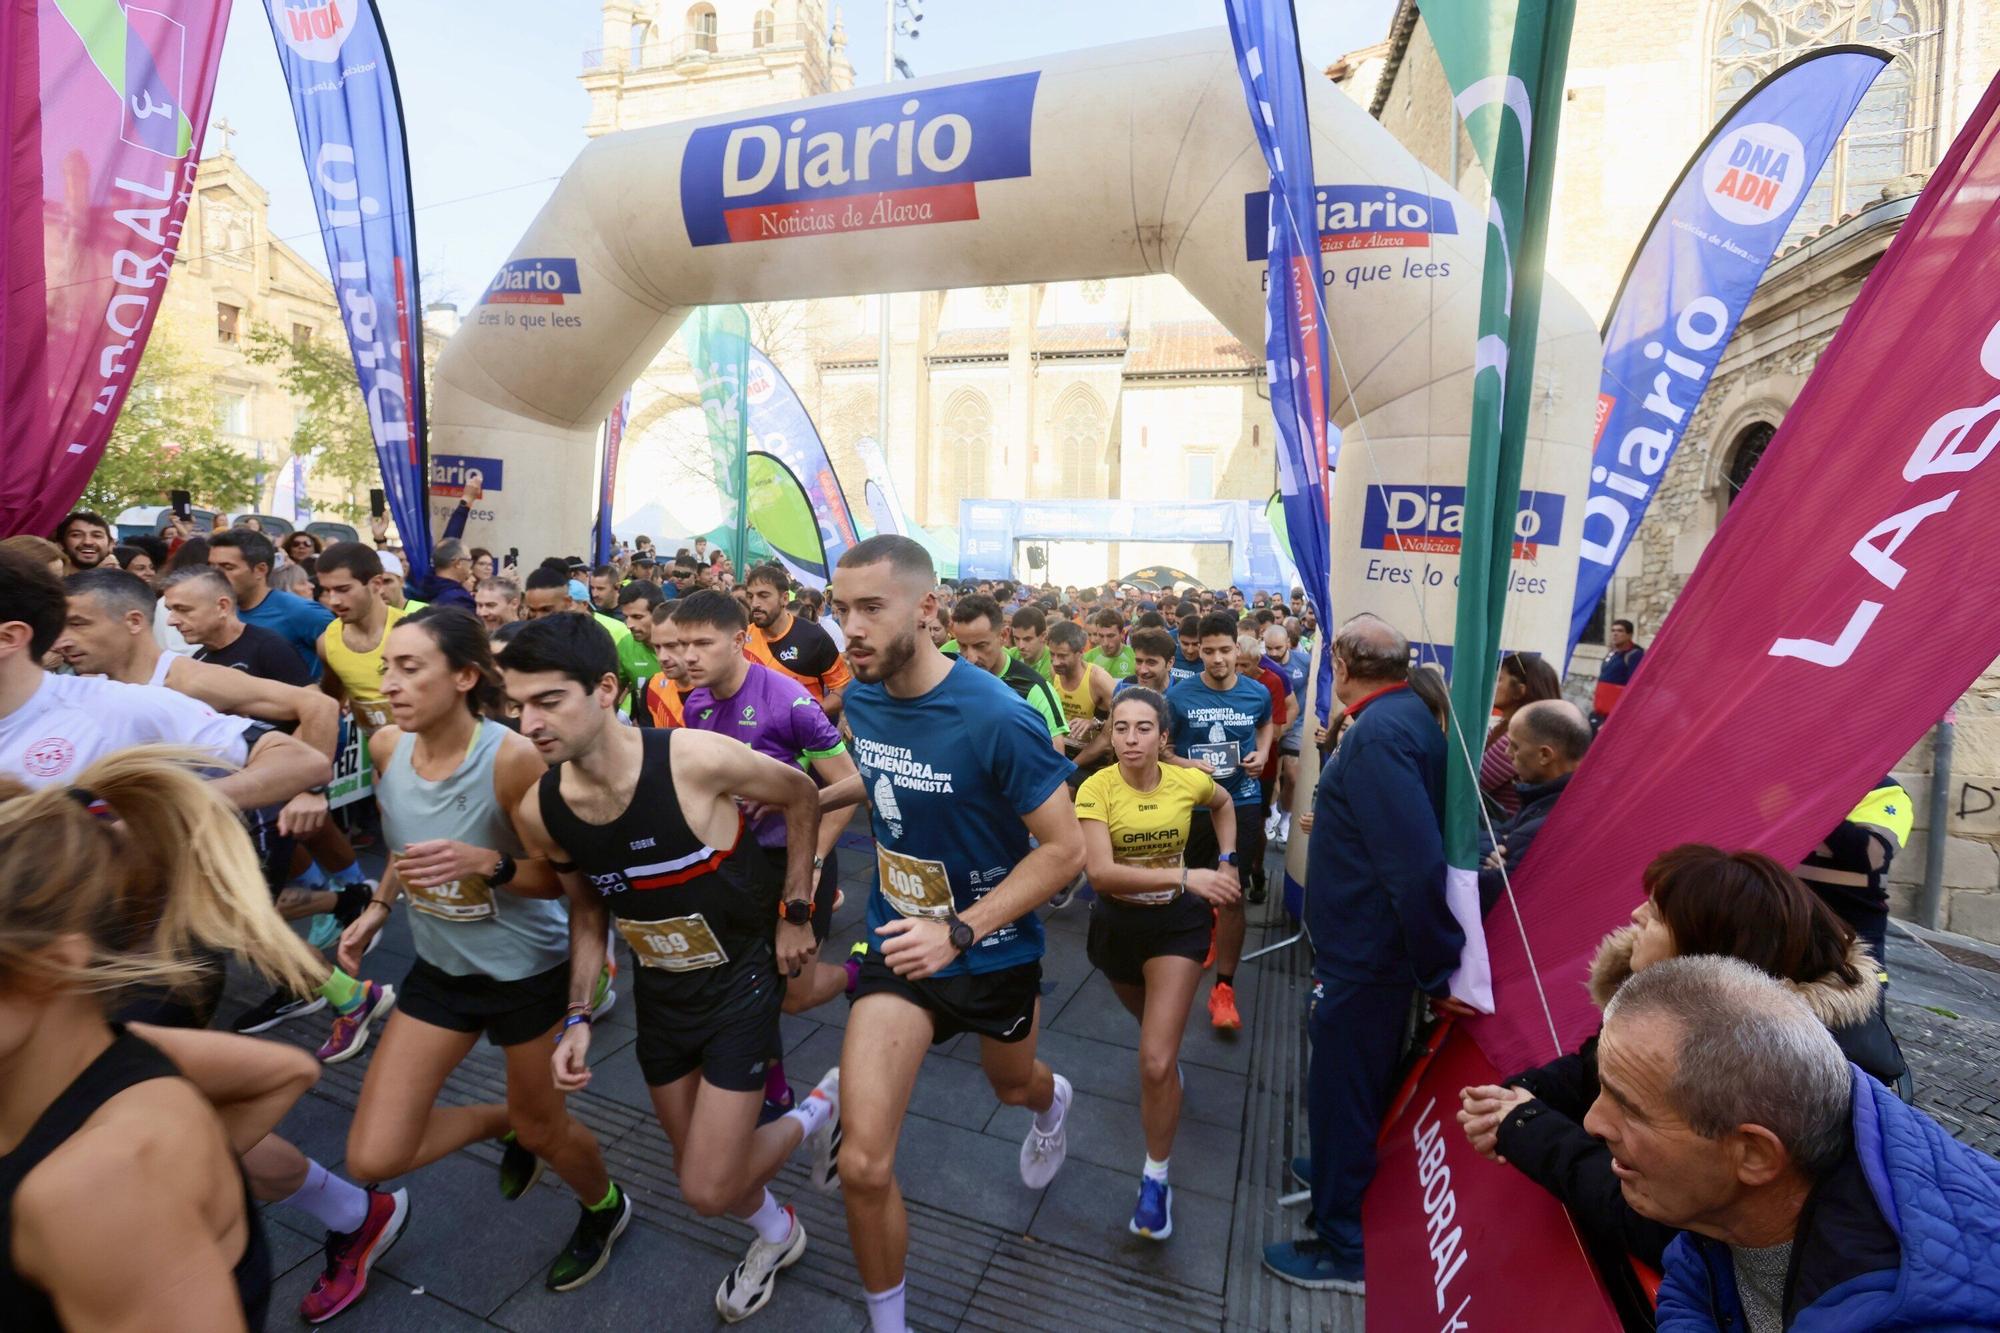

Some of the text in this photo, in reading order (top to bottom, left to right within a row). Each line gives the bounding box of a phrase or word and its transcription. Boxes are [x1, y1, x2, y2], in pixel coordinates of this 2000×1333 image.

[722, 99, 972, 197] Diario
[1728, 138, 1790, 183] DNA
[1715, 168, 1780, 211] ADN
[760, 192, 933, 238] Noticias de Álava
[1316, 190, 1428, 231] iario
[1319, 231, 1405, 252] cias de Álava
[491, 261, 562, 291] Diario
[1346, 263, 1392, 290] que
[1402, 257, 1451, 279] lees
[520, 313, 546, 331] que
[551, 311, 582, 328] lees
[1578, 295, 1729, 566] Diario
[432, 459, 484, 485] iario
[470, 509, 495, 521] ees
[1386, 491, 1541, 538] Diao
[1403, 537, 1456, 554] Noticias
[1366, 558, 1414, 585] Eres
[1422, 562, 1444, 586] lo
[1508, 570, 1548, 595] lees
[1196, 707, 1234, 715] CONQUISTA
[1198, 713, 1247, 722] ALMENDRA
[860, 738, 912, 761] CONQUISTA
[861, 750, 933, 780] ALMENDRA
[894, 774, 954, 793] KONKISTA
[1123, 828, 1179, 843] GAIKAR
[888, 866, 925, 899] 406
[643, 932, 689, 954] 169
[1413, 1096, 1468, 1315] LABORAL
